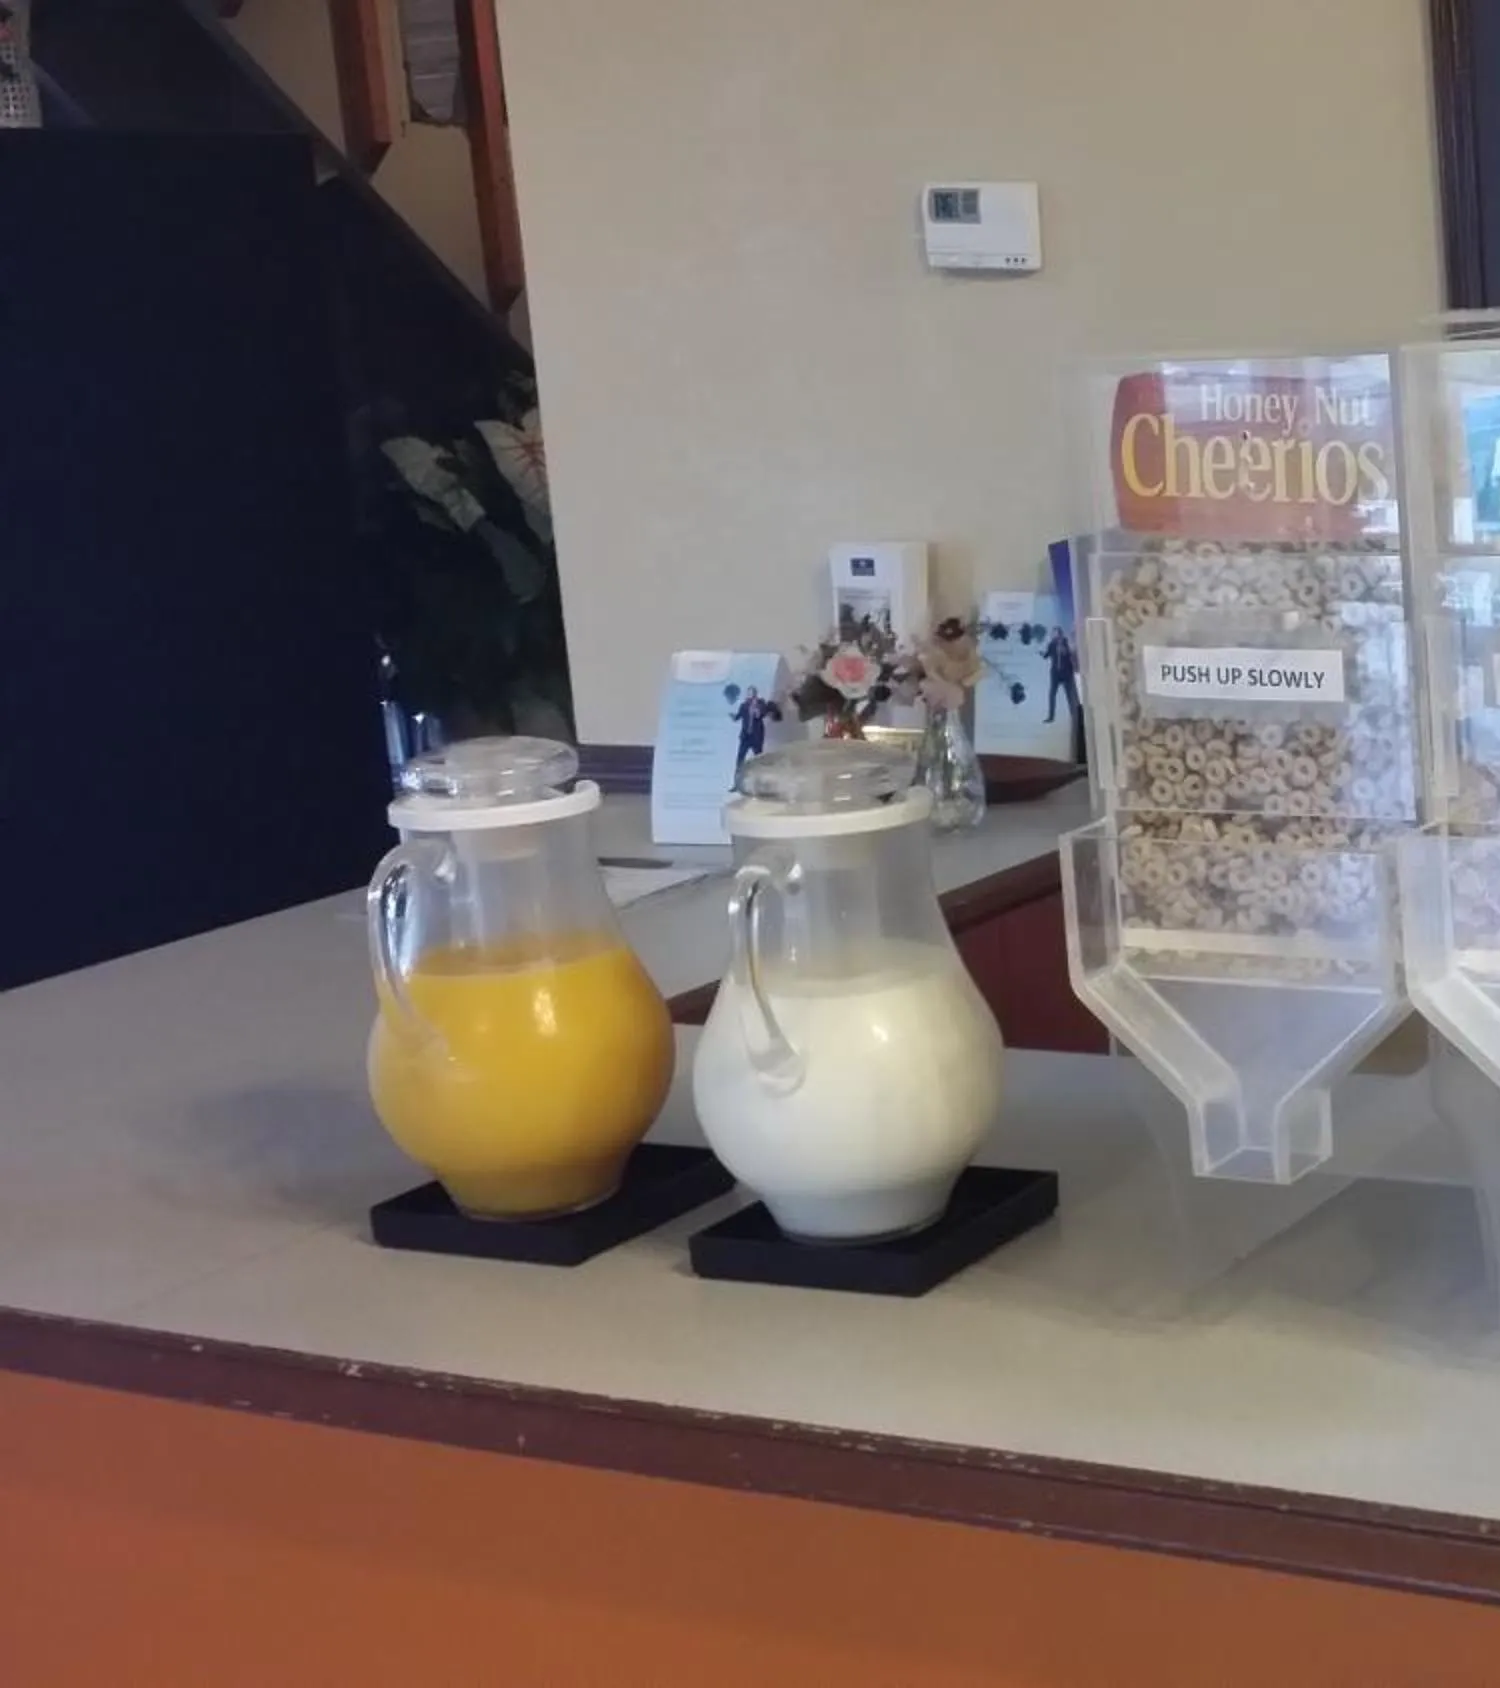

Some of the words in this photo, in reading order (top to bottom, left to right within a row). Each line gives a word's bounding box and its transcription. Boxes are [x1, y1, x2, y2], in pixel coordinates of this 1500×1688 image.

[1200, 383, 1297, 434] Honey
[1315, 386, 1377, 427] Nut
[1121, 413, 1388, 506] Cheerios
[1161, 664, 1211, 684] PUSH
[1216, 667, 1243, 686] UP
[1247, 669, 1325, 689] SLOWLY
